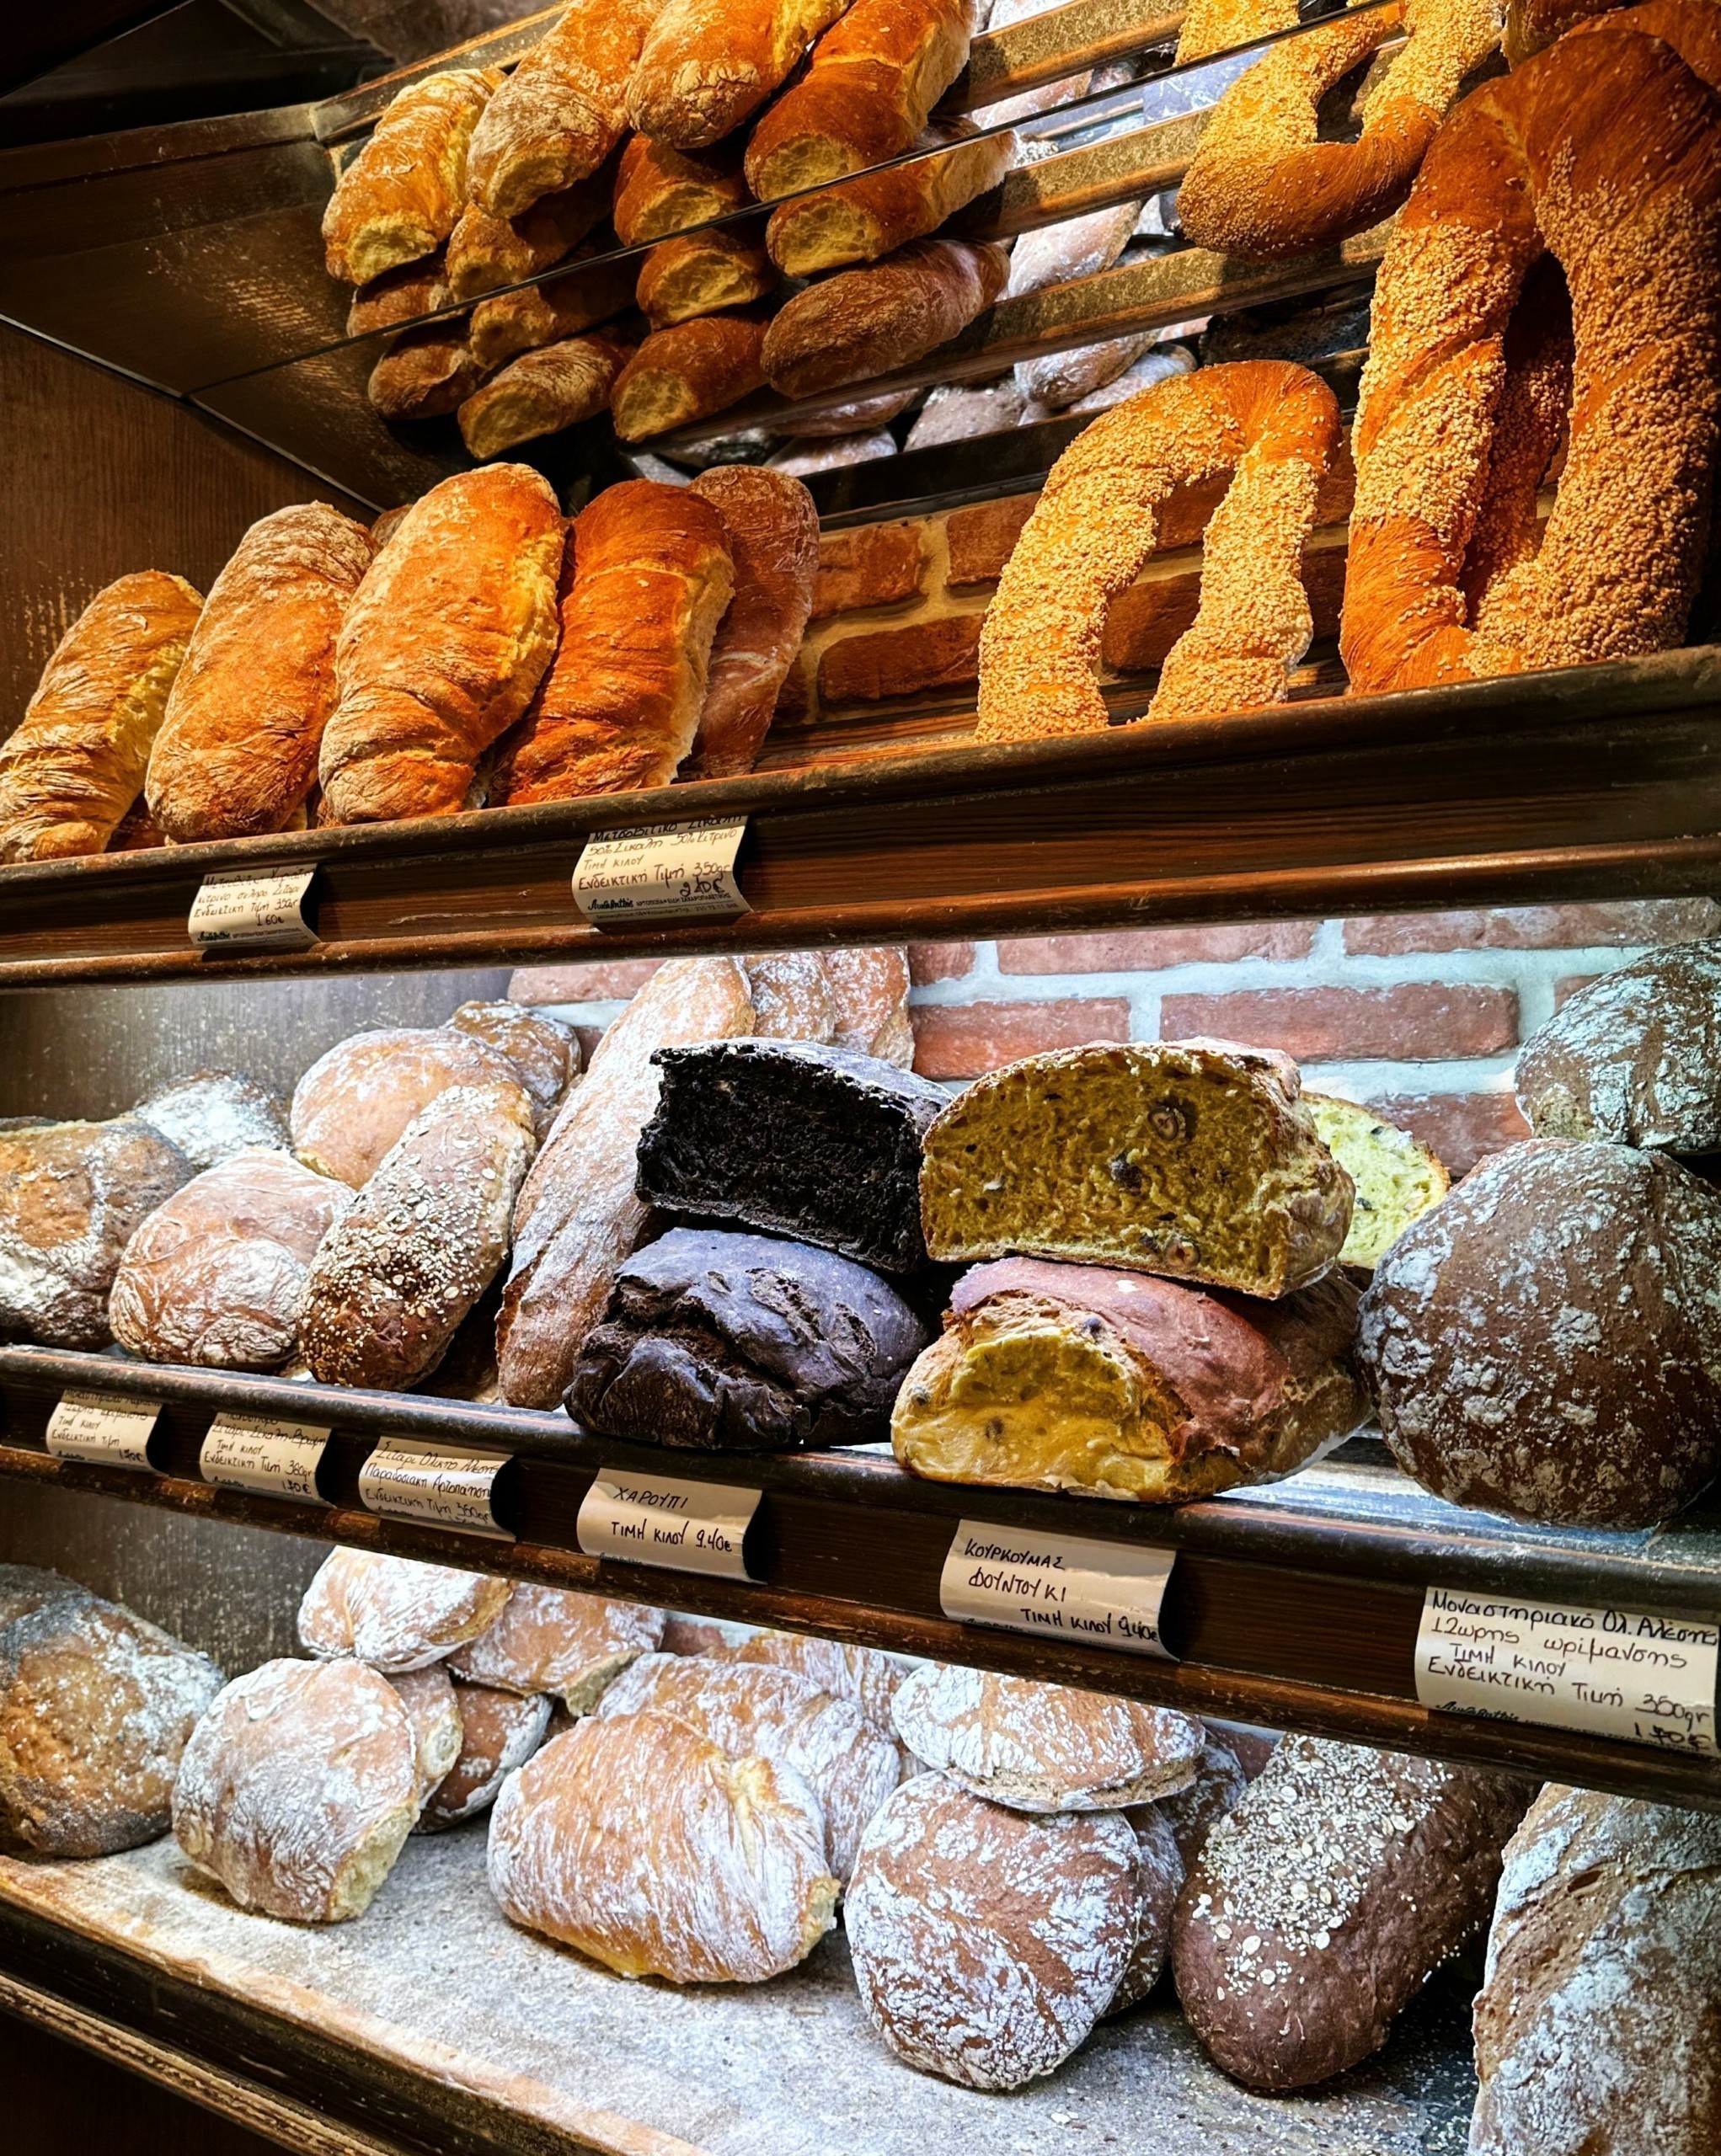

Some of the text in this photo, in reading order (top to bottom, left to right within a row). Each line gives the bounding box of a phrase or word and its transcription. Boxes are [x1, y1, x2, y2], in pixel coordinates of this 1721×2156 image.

[613, 1486, 688, 1509] ΧΑΡΟΥΠΙ
[695, 1528, 733, 1553] 9.40€
[964, 1538, 1066, 1571] ΚΟΥΡΚΟΥΜΑΣ
[1432, 1590, 1595, 1631] Μοναστηριακό
[1431, 1616, 1688, 1669] 12ωρης ωρίμανσης
[1428, 1655, 1556, 1695] Ενδεικτική
[1571, 1682, 1624, 1708] Τιμή
